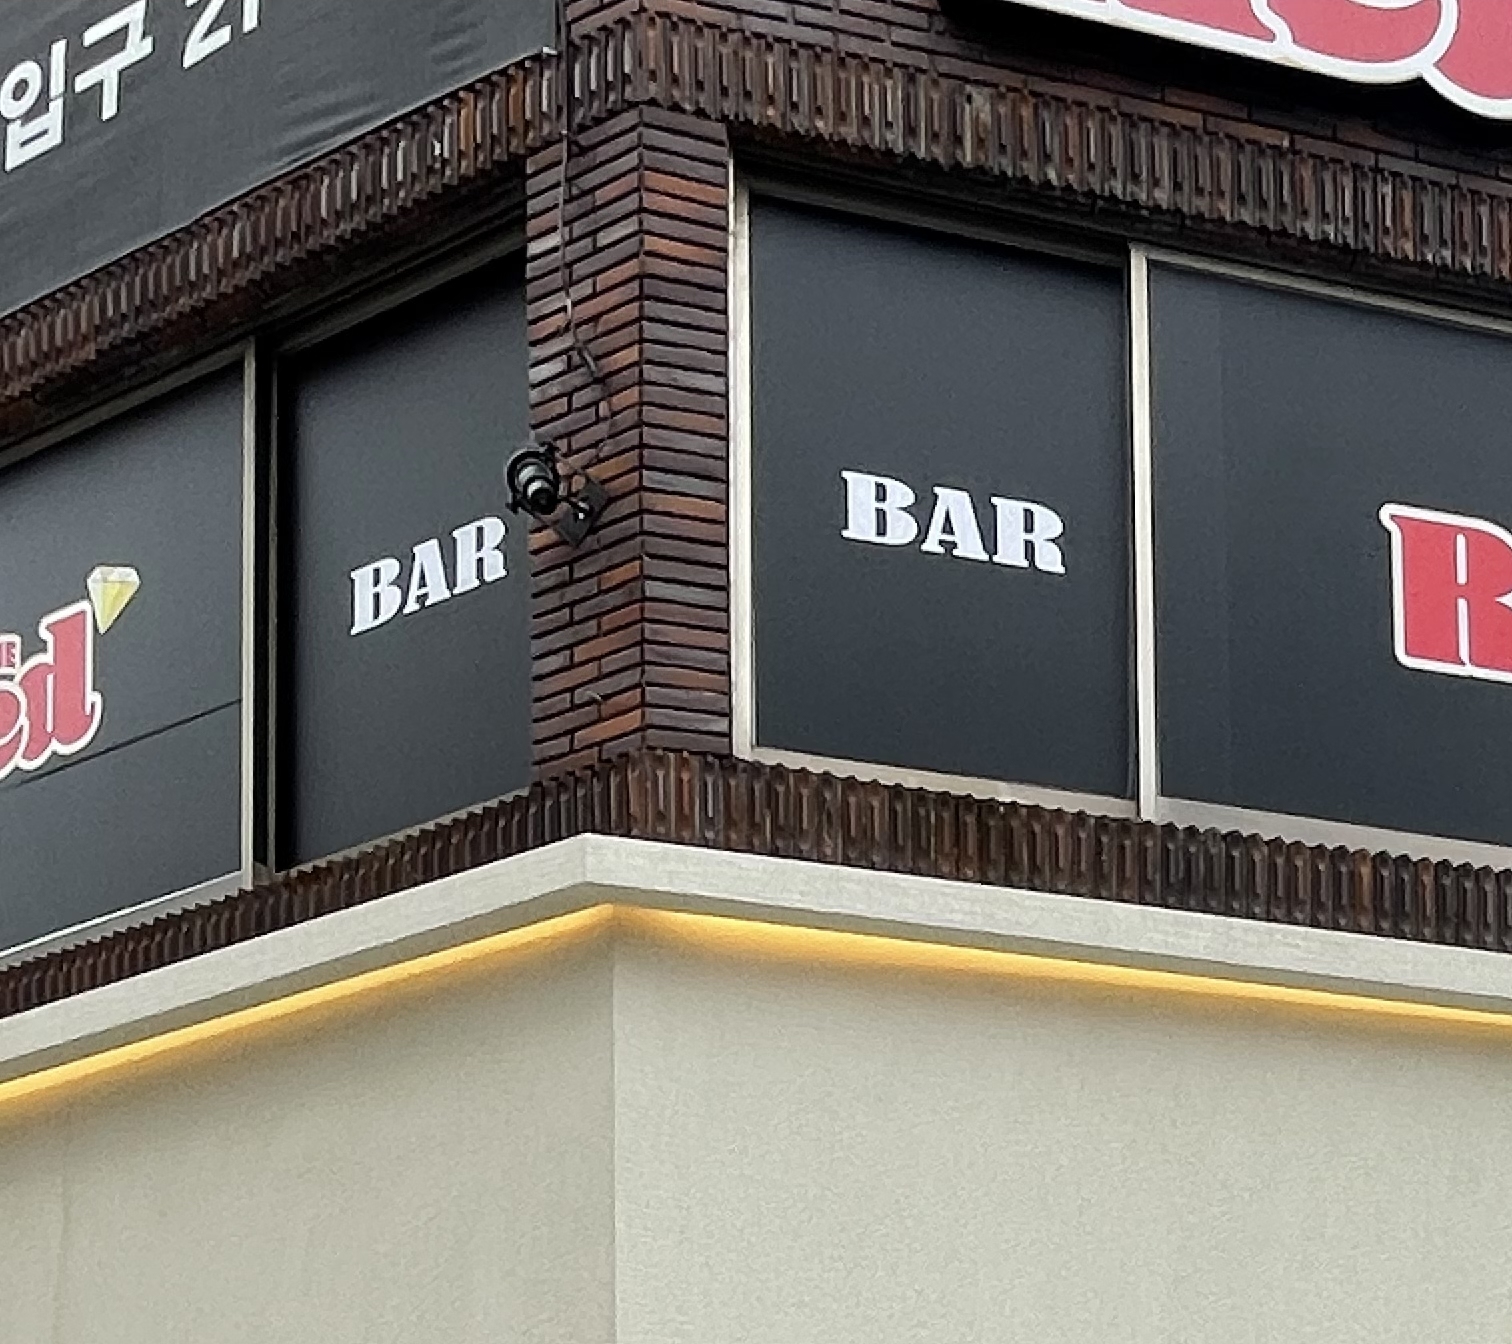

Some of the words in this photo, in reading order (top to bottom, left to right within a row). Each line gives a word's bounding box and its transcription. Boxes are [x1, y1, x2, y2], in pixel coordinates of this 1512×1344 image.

[0, 0, 154, 173] 입구
[182, 0, 260, 70] 2
[350, 517, 507, 636] BAR
[841, 467, 1067, 576] BAR
